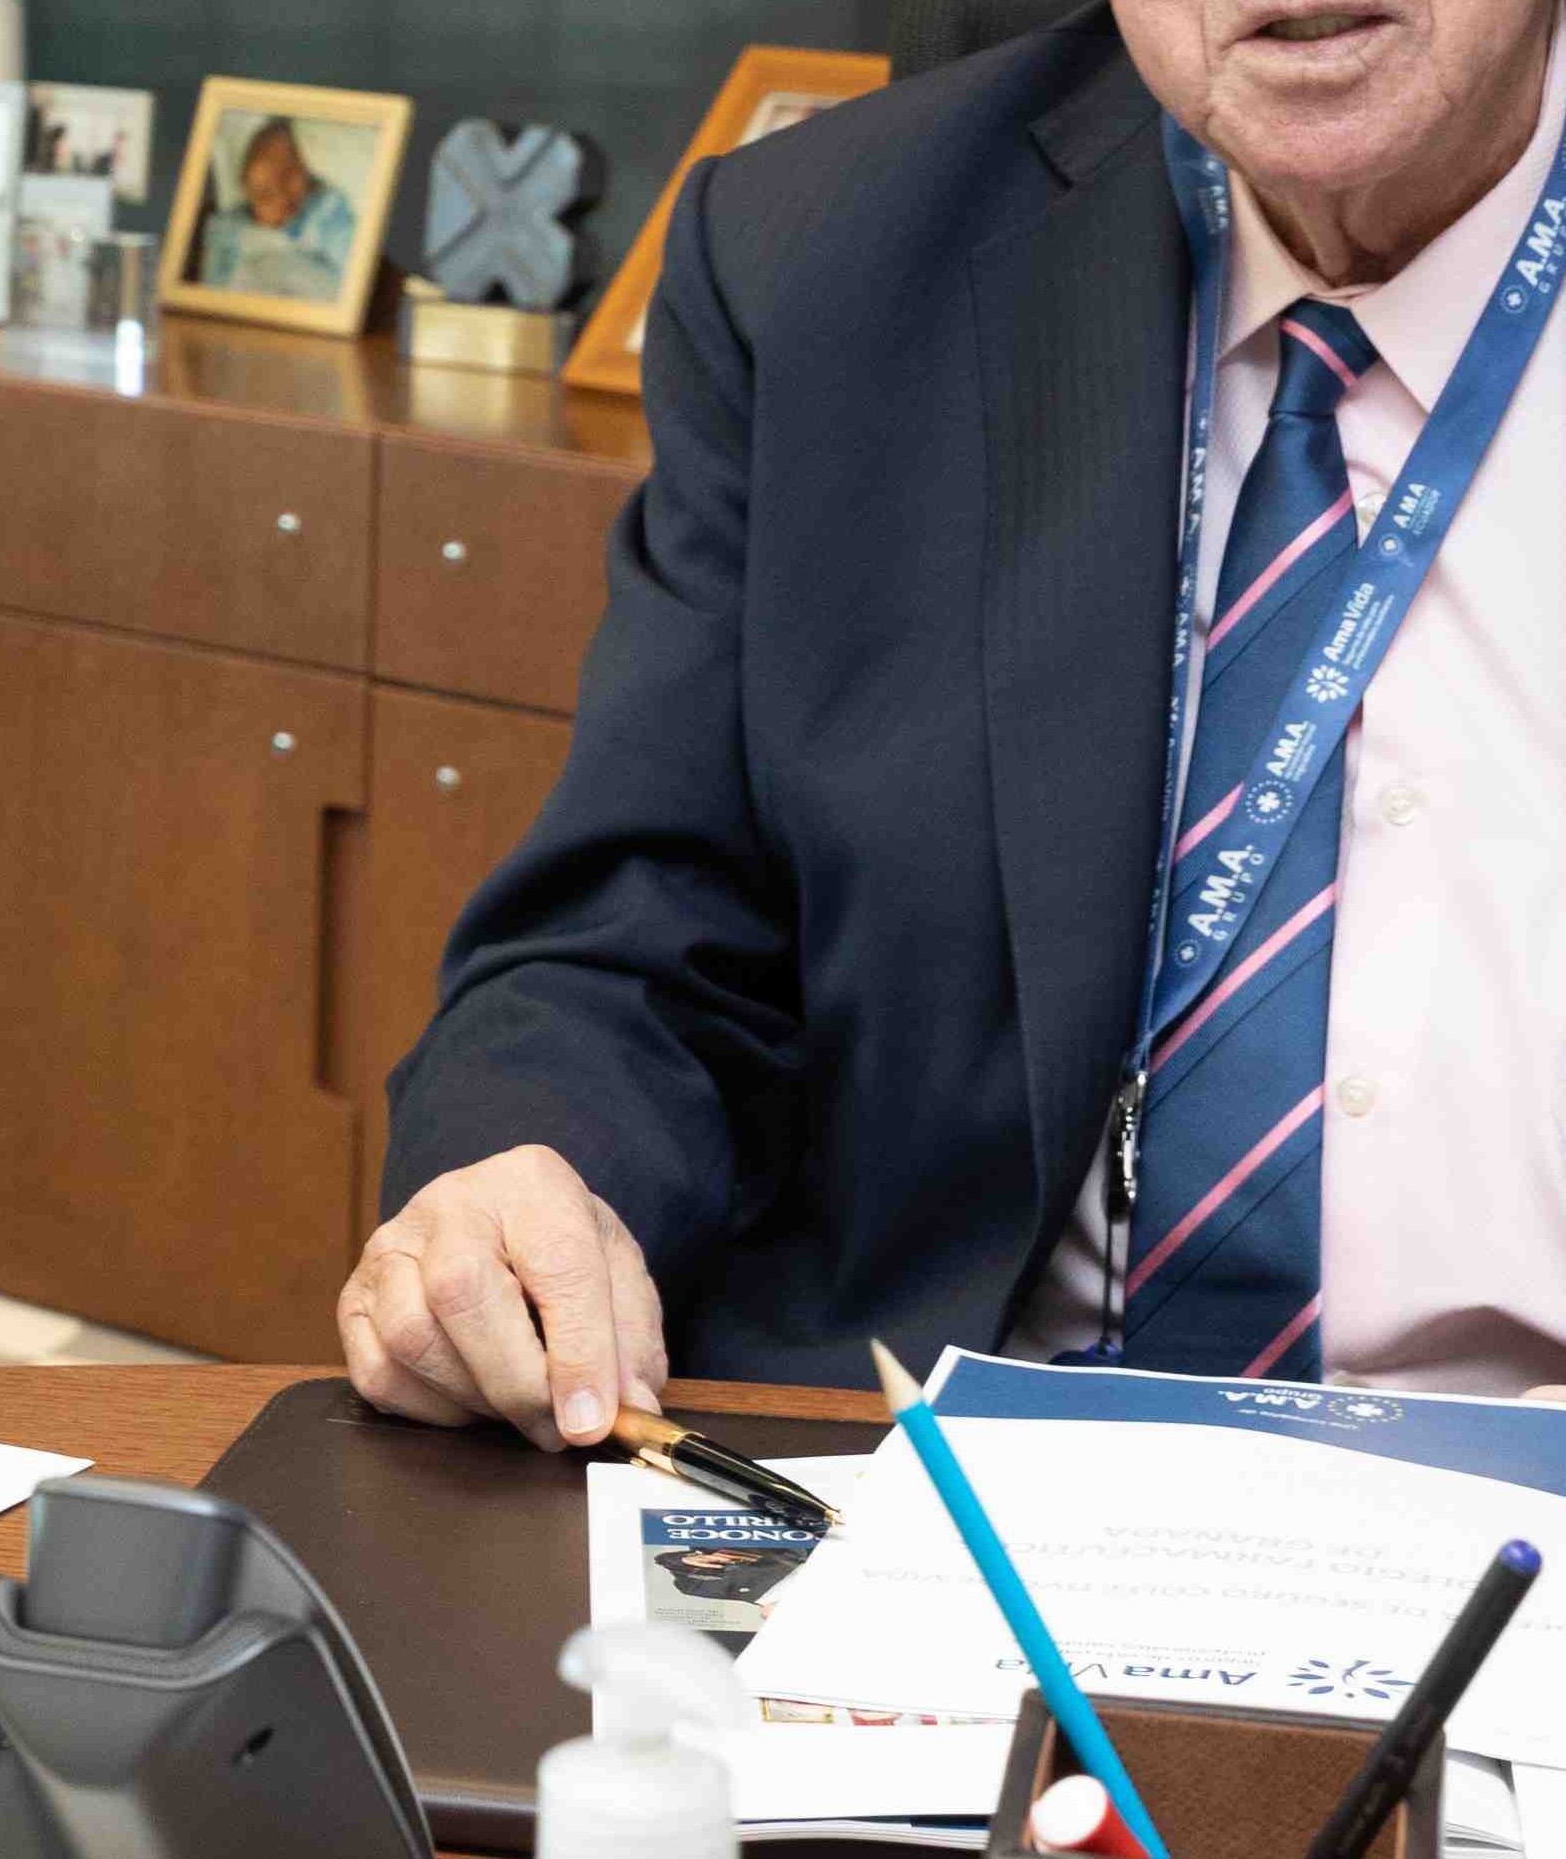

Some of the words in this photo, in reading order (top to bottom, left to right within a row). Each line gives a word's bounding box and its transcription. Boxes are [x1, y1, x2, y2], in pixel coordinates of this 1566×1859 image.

[1188, 845, 1254, 937] A.M.A.
[1211, 854, 1265, 941] GRUPO
[667, 1528, 820, 1541] ONOCE
